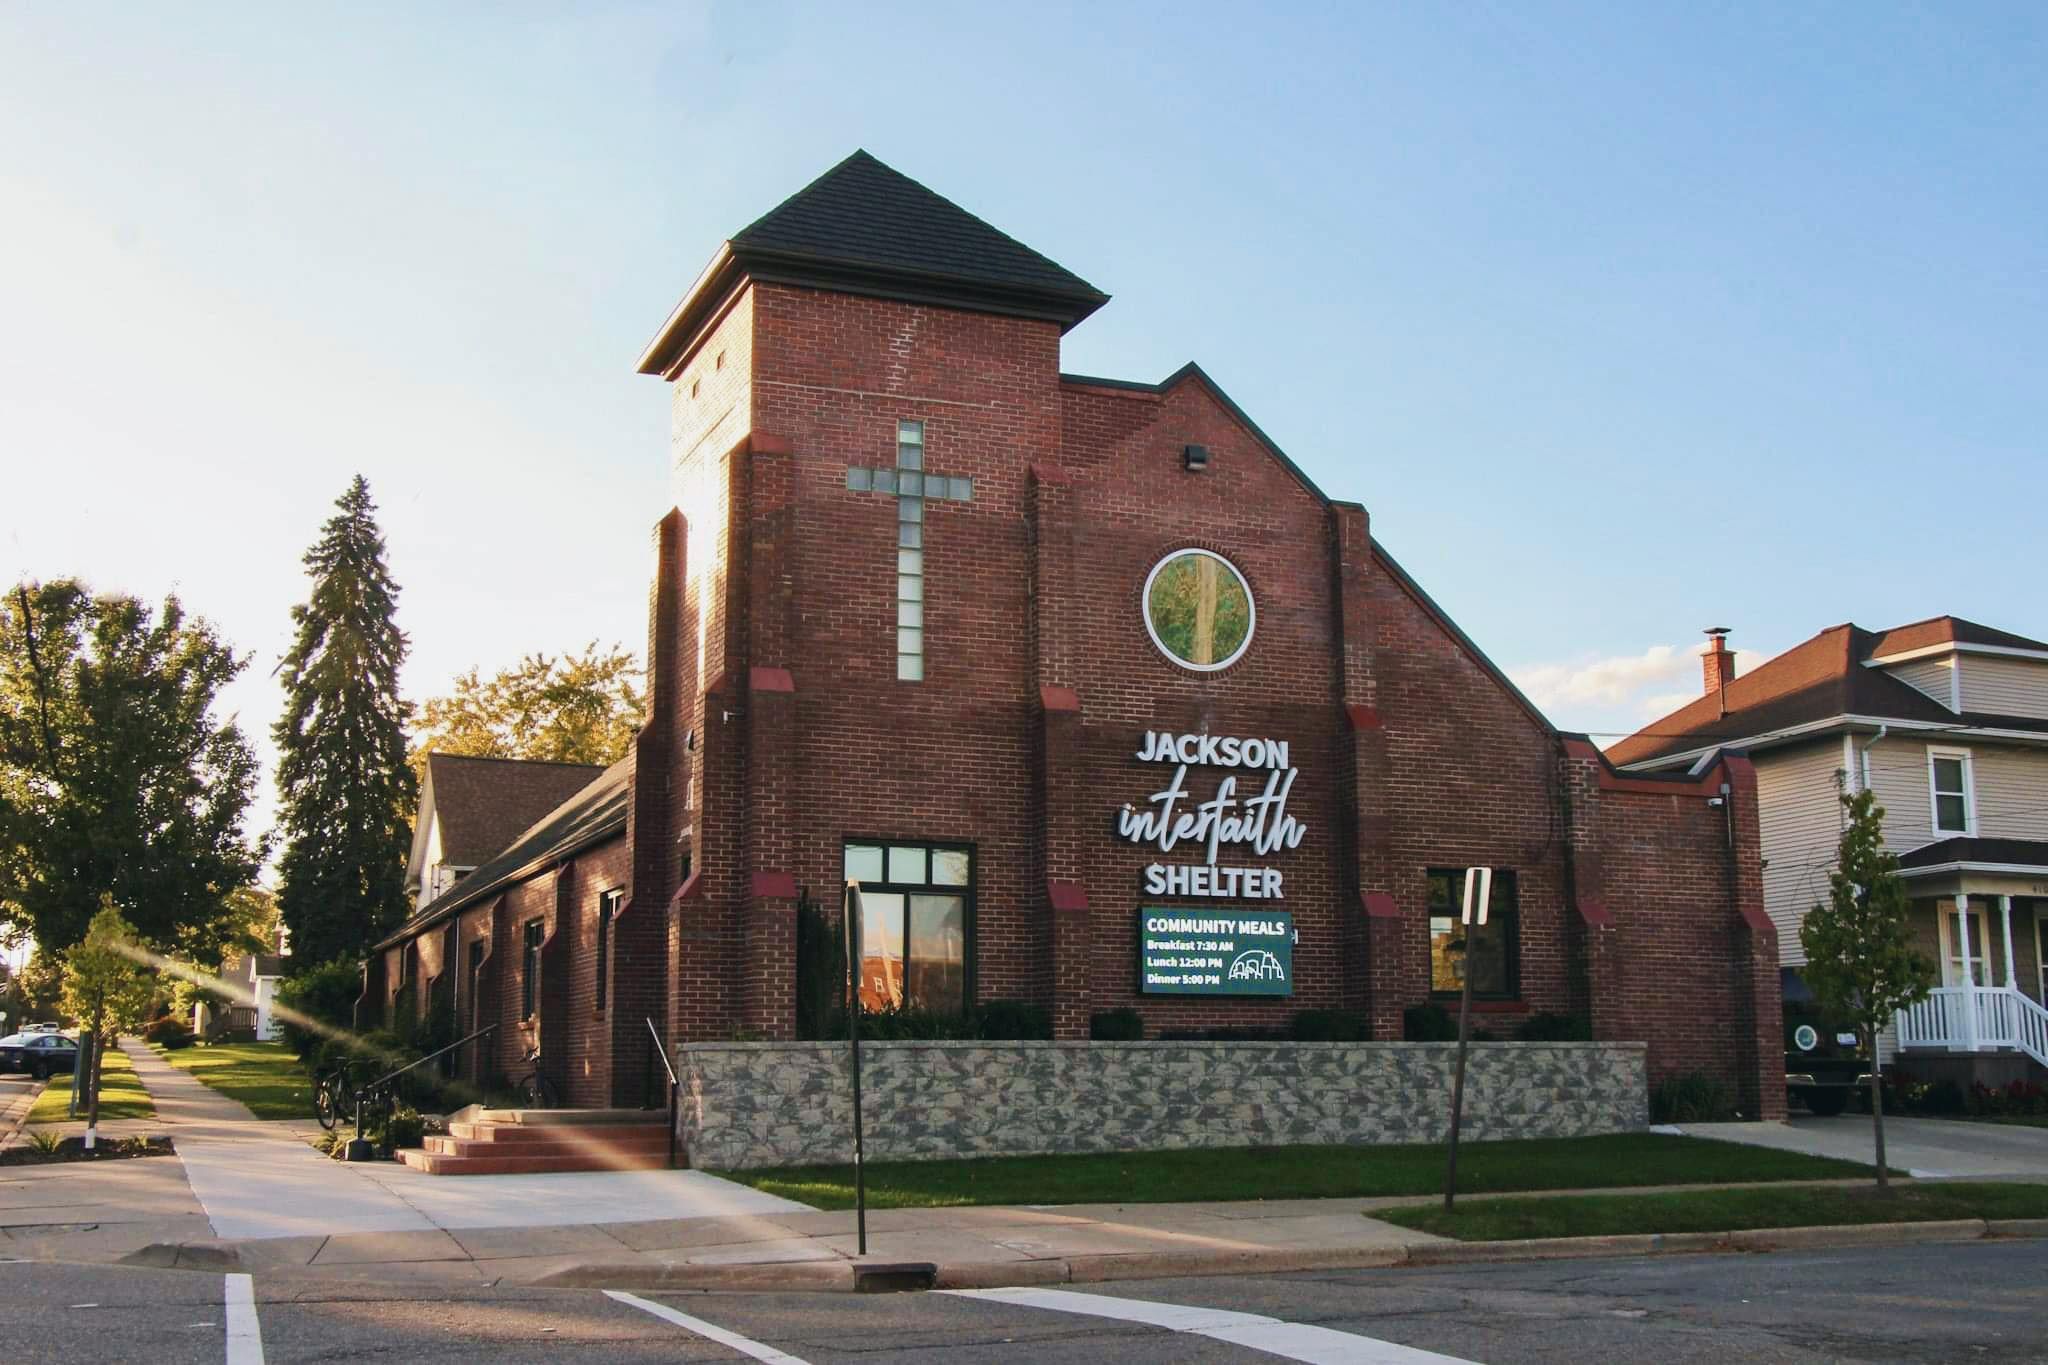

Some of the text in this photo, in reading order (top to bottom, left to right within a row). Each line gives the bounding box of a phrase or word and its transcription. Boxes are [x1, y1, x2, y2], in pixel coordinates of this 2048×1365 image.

[1136, 730, 1289, 769] JACKSON
[1119, 765, 1307, 864] interfaith
[1144, 863, 1284, 898] SHELTER
[1147, 918, 1285, 936] COMMUNITY MEALS
[1147, 940, 1234, 952] Breakfast 7:30 AM
[1147, 957, 1223, 968] Lunch 12:00 PM
[1147, 974, 1220, 985] Dinner 5:00 PM
